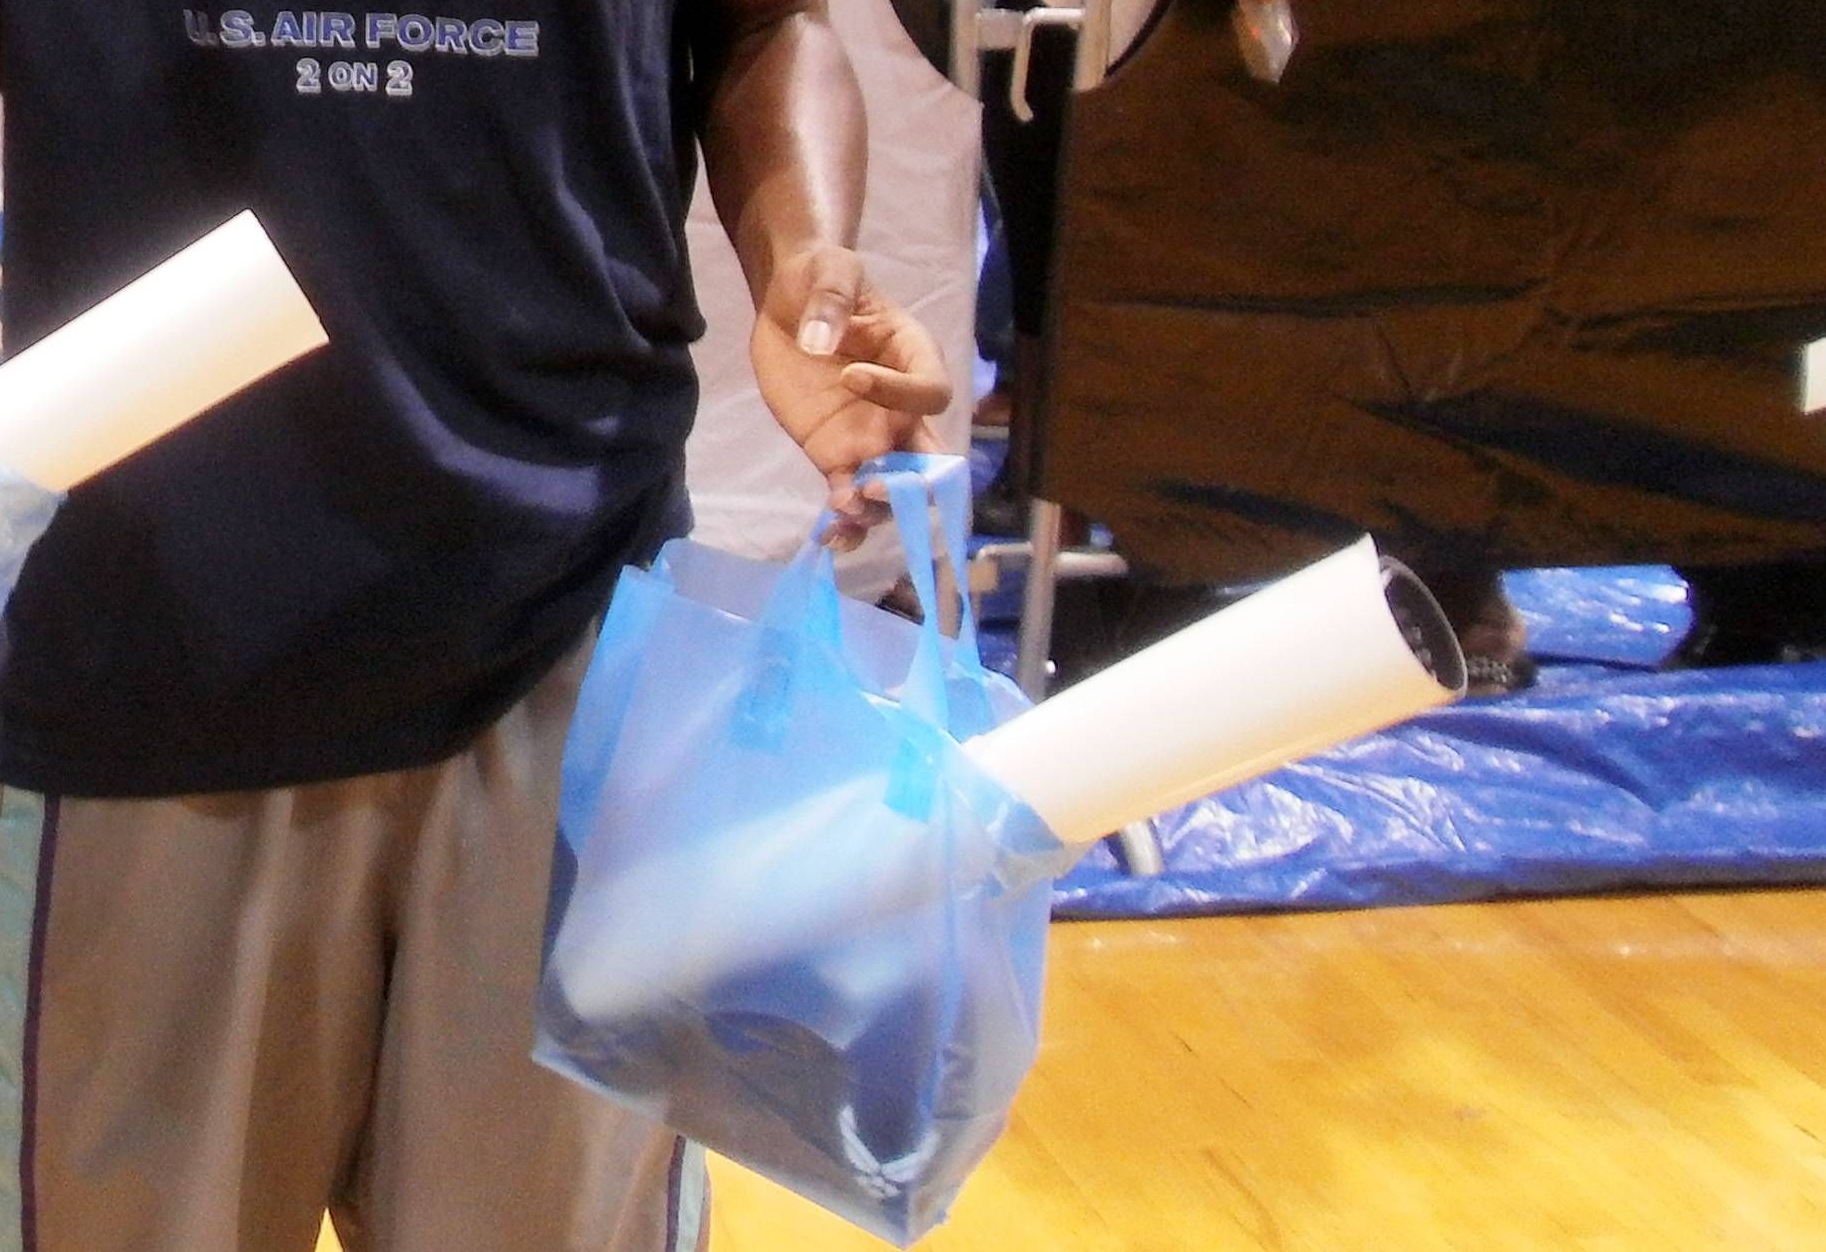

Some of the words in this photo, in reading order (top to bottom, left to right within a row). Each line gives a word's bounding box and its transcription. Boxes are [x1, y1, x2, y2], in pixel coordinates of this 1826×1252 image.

[182, 9, 266, 48] U.S.
[271, 11, 355, 48] AIR
[365, 12, 540, 56] FORCE
[295, 57, 321, 94] 2
[328, 61, 378, 91] ON
[385, 60, 413, 96] 2
